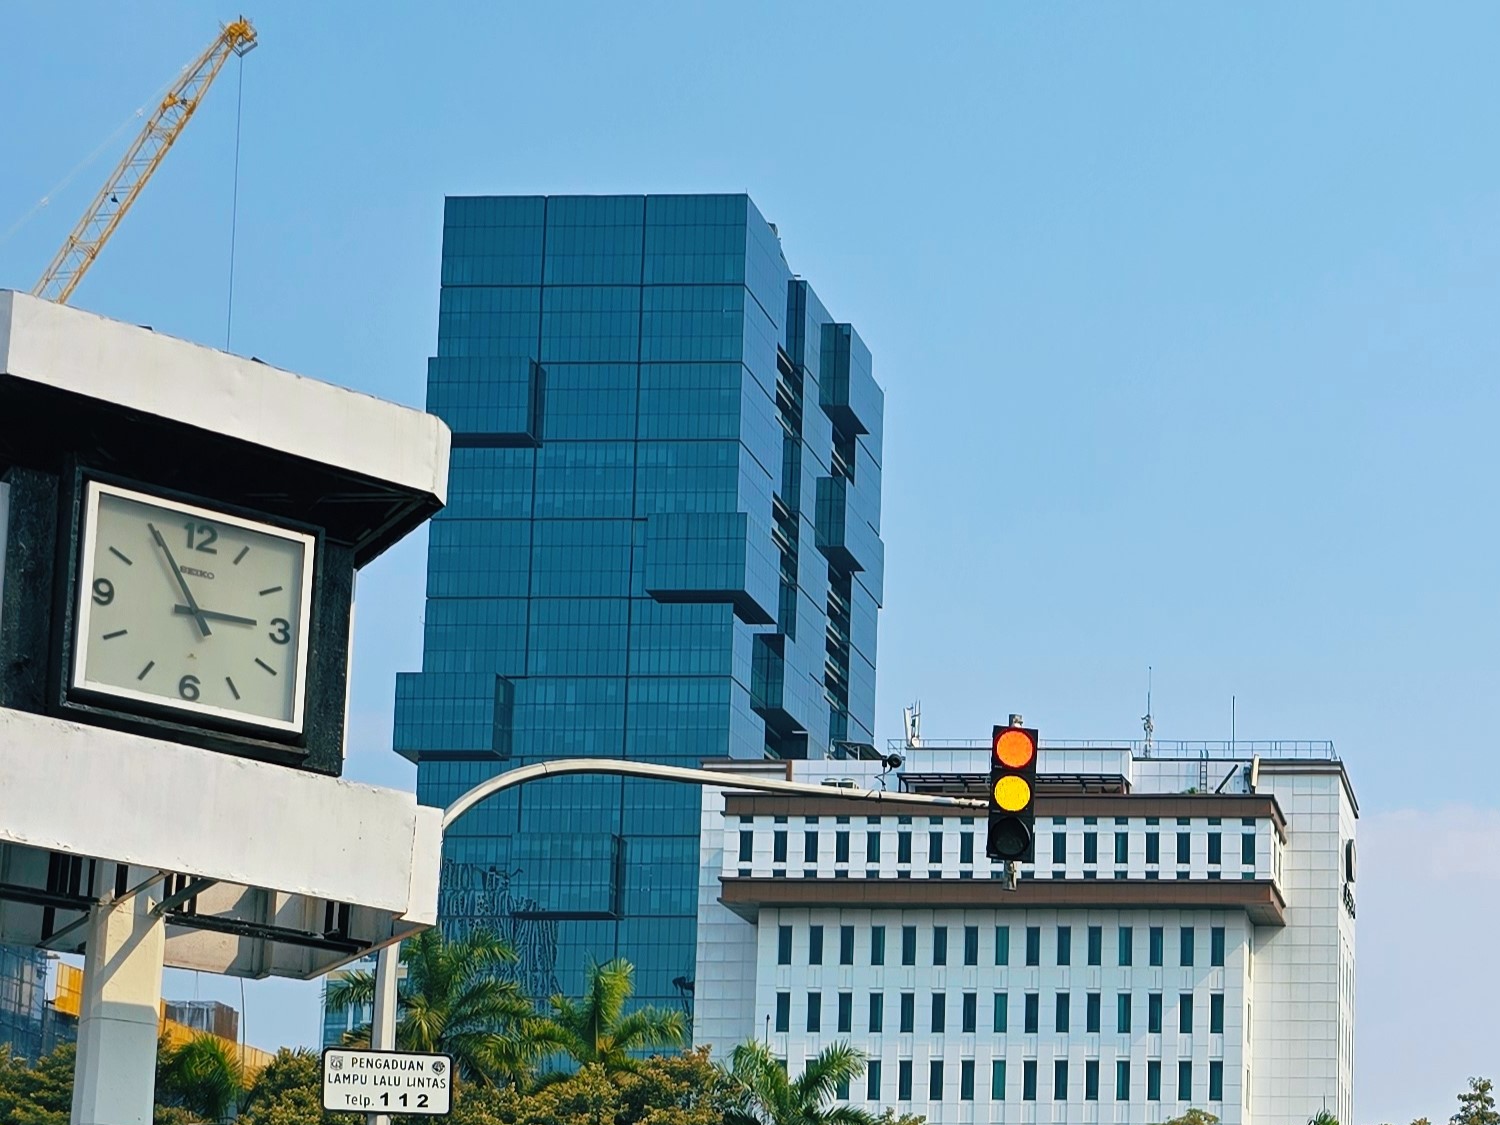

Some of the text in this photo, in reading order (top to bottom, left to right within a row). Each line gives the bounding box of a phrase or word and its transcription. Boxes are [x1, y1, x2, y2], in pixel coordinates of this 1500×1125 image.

[184, 522, 218, 554] 12
[180, 565, 214, 580] SEIKO
[92, 578, 115, 606] 9
[269, 618, 290, 644] 3
[179, 675, 200, 700] 6
[351, 1057, 424, 1071] PENGADUAN
[328, 1073, 446, 1089] LAMPU LALU LINTAS
[345, 1094, 374, 1108] Telp.
